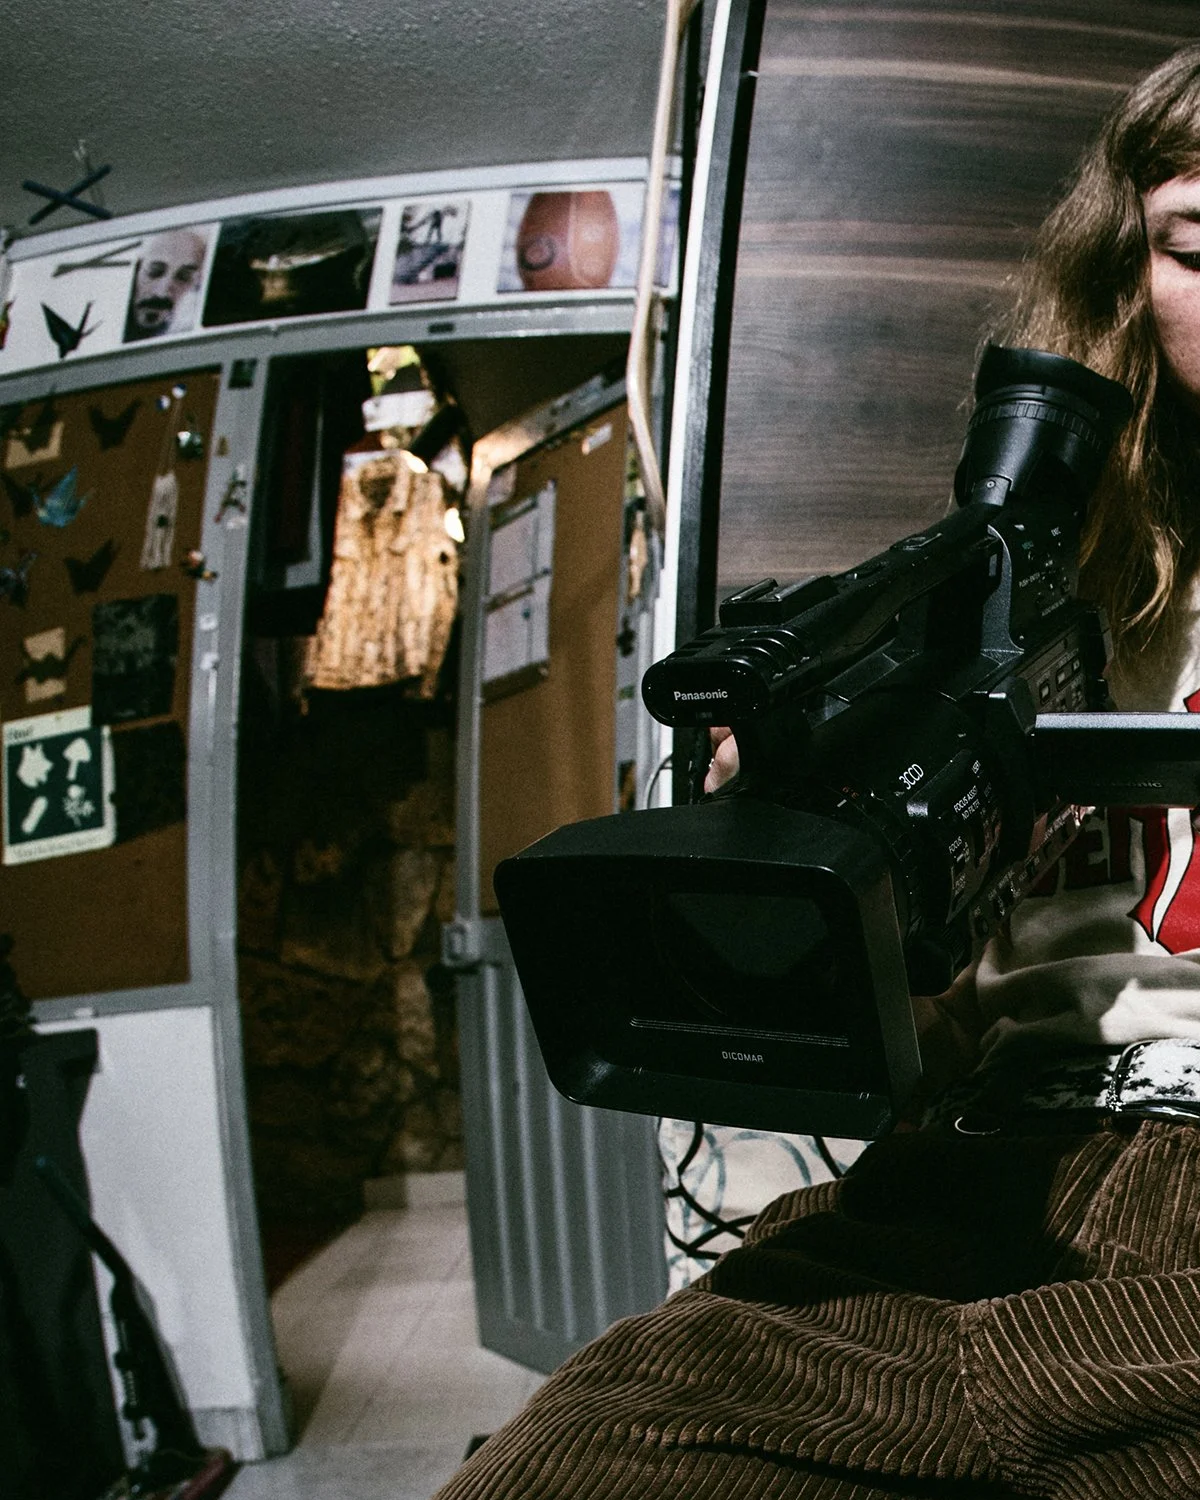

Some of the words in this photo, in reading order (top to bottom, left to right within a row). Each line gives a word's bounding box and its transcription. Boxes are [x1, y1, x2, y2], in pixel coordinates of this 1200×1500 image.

[673, 688, 729, 701] Panasonic
[898, 763, 924, 790] 3CCD
[721, 1051, 765, 1063] DICOMAR
